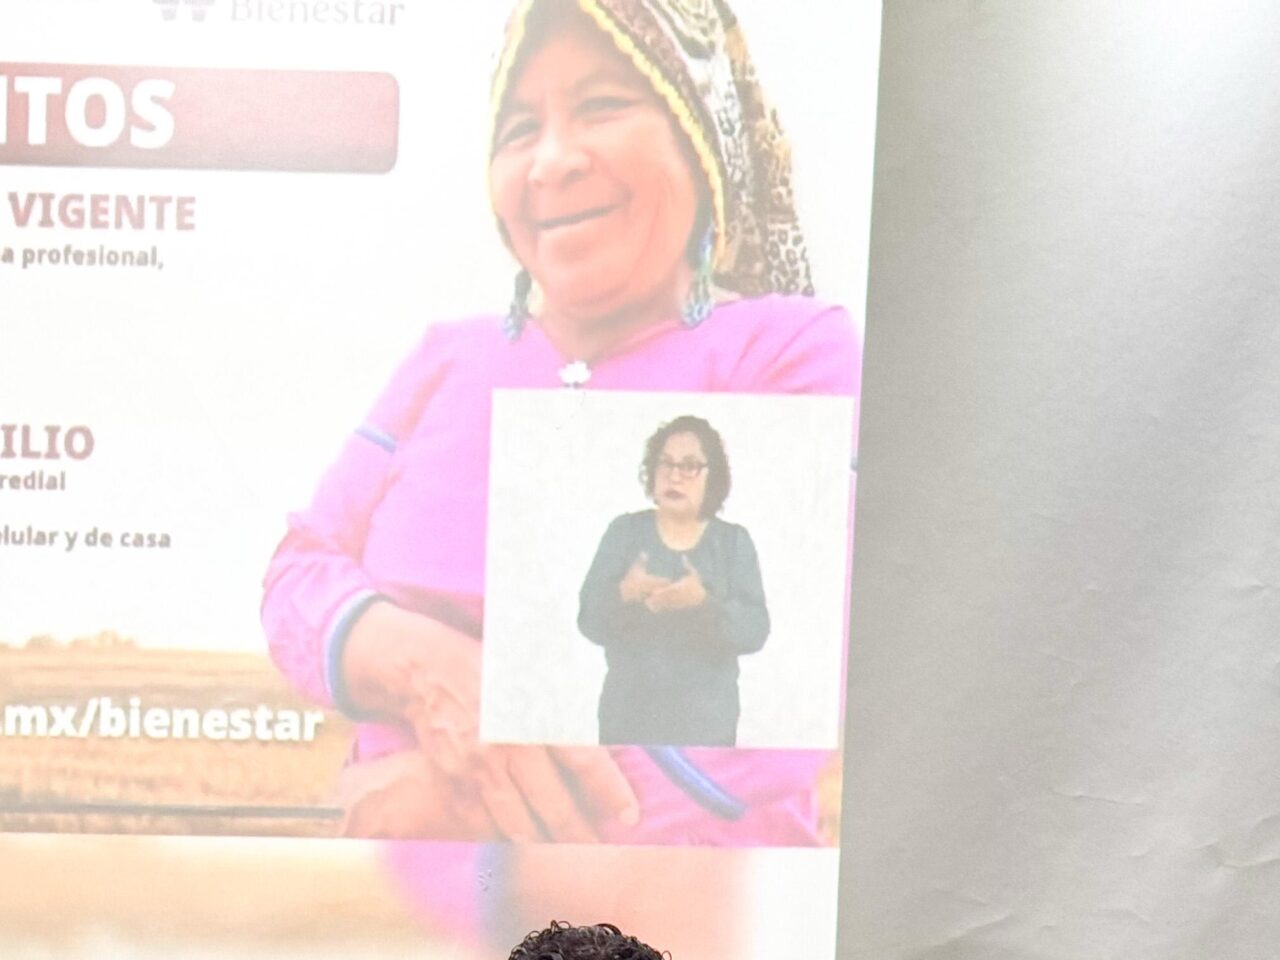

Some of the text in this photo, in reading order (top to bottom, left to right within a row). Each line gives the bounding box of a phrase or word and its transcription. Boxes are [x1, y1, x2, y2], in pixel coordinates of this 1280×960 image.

[8, 191, 197, 231] VIGENTE
[21, 245, 164, 271] profesional,
[65, 532, 78, 551] y
[85, 527, 113, 548] de
[120, 531, 172, 549] casa
